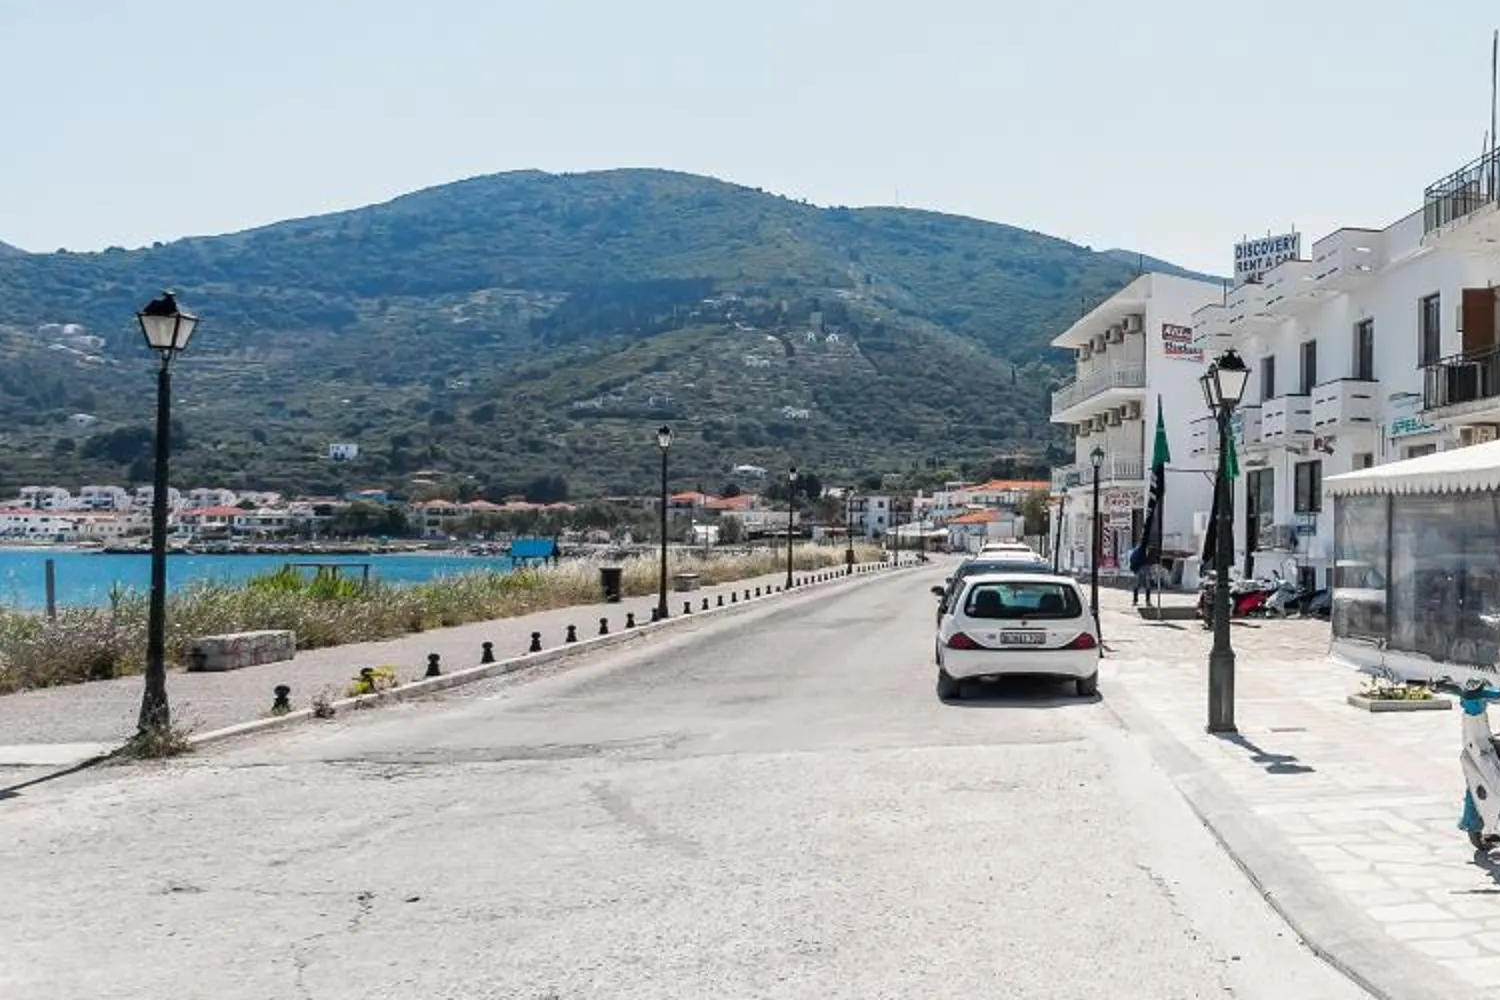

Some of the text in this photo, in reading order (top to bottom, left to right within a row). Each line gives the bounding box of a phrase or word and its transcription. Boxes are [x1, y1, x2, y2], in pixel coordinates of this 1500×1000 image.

[1235, 235, 1297, 259] DISCOVERY
[1236, 257, 1262, 272] RENT
[1265, 256, 1273, 268] A
